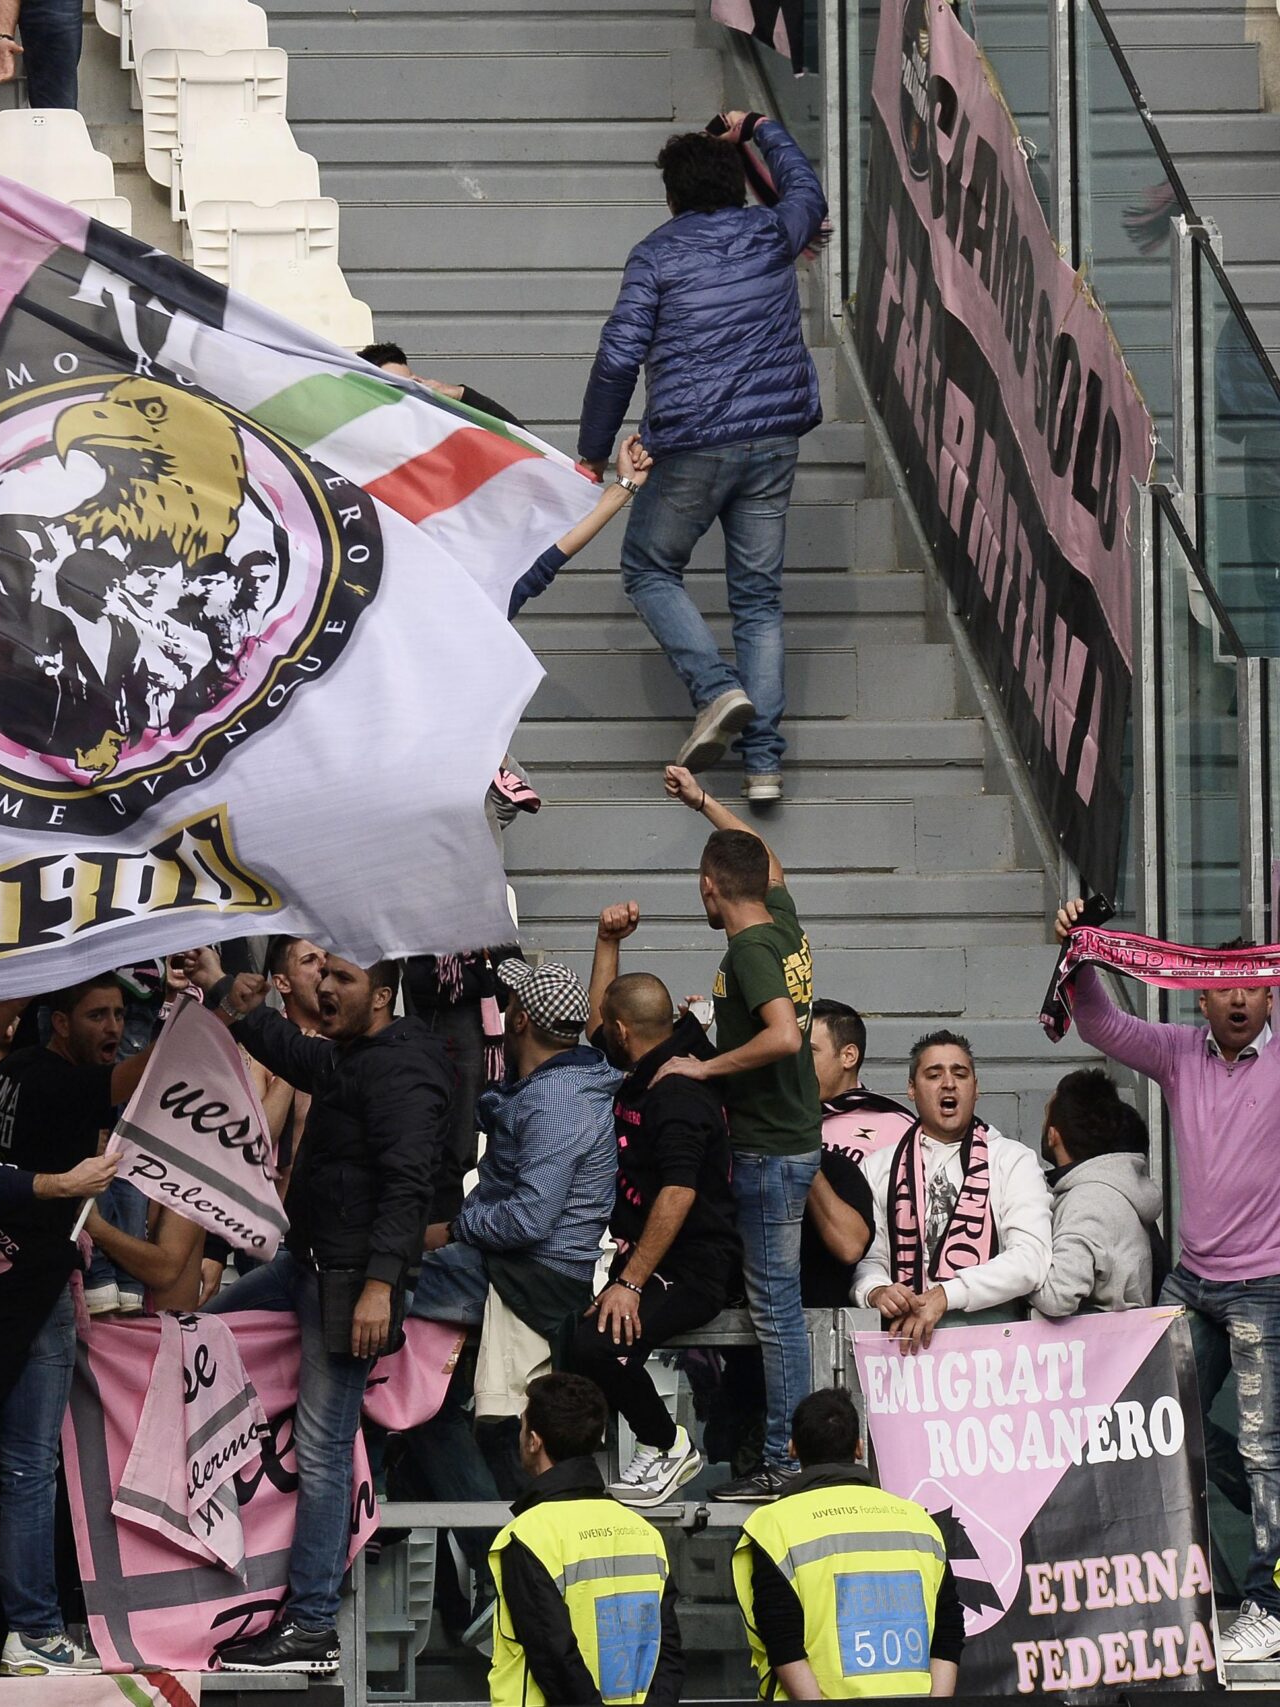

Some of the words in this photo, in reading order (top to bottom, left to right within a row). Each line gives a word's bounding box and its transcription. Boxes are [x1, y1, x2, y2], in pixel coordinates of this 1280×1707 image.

[1033, 288, 1121, 552] SOLO
[107, 617, 346, 816] OVUNQUE
[128, 1154, 267, 1248] Palermo
[864, 1340, 1087, 1415] EMIGRATI
[923, 1395, 1186, 1479] ROSANERO
[578, 1527, 613, 1541] JUVENTUS
[811, 1506, 859, 1520] JUVENTUS
[1024, 1543, 1213, 1616] ETERNA
[853, 1627, 924, 1669] 509
